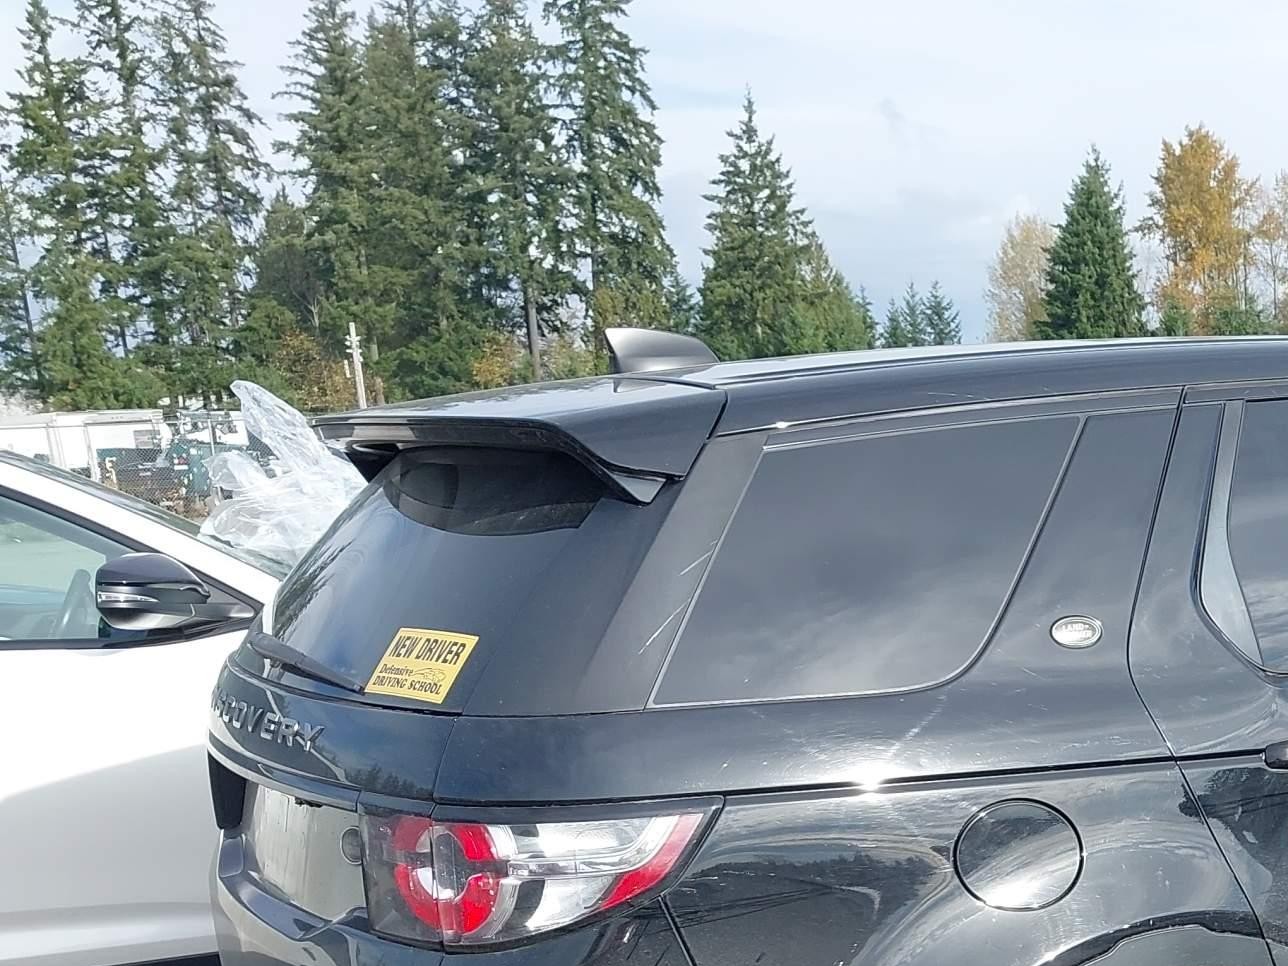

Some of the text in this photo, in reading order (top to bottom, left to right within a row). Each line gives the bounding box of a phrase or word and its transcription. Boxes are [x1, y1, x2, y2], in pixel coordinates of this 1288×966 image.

[389, 636, 466, 665] NEW DRIVER
[379, 664, 413, 677] Defensive
[372, 676, 442, 695] DRIVING SCHOOL
